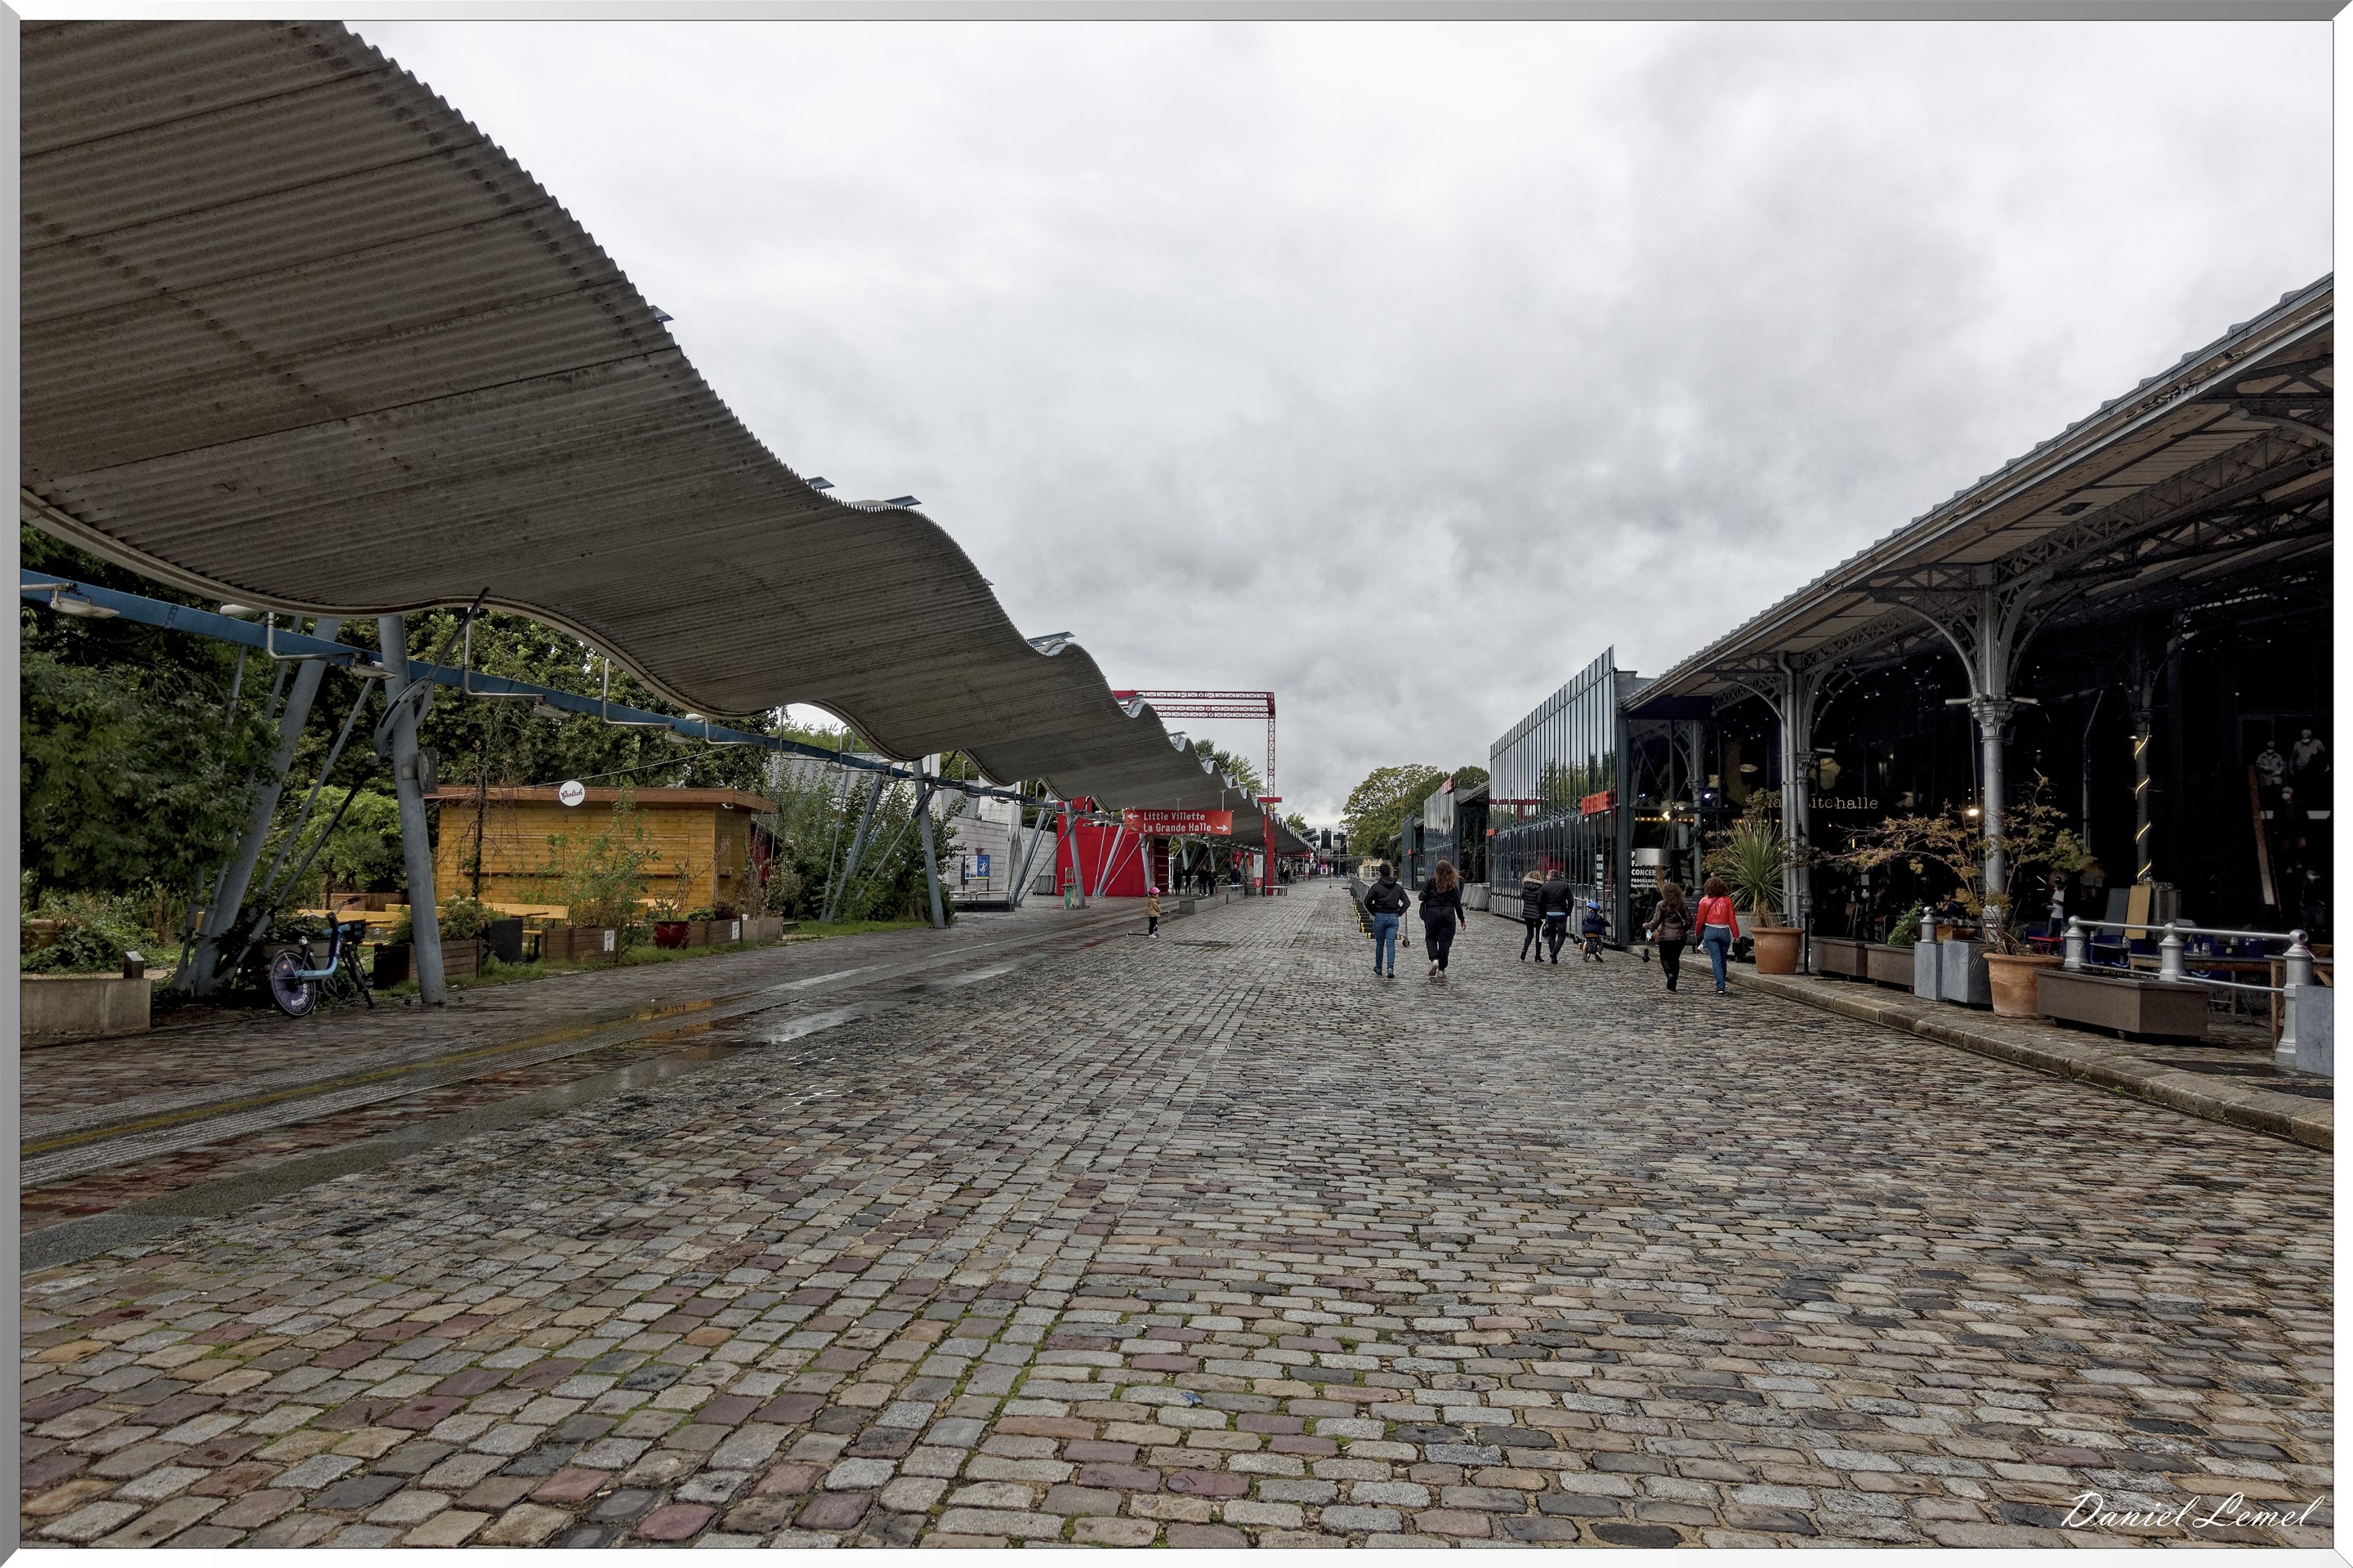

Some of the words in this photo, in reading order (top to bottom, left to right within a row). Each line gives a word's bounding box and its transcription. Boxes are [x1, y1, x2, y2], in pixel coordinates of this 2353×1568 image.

[560, 788, 583, 799] Grolsch
[1835, 797, 1878, 809] halle
[1144, 811, 1169, 820] Little
[1171, 811, 1205, 820] Villette
[1144, 824, 1153, 832] La
[1155, 824, 1186, 832] Grande
[1188, 823, 1212, 832] Halle
